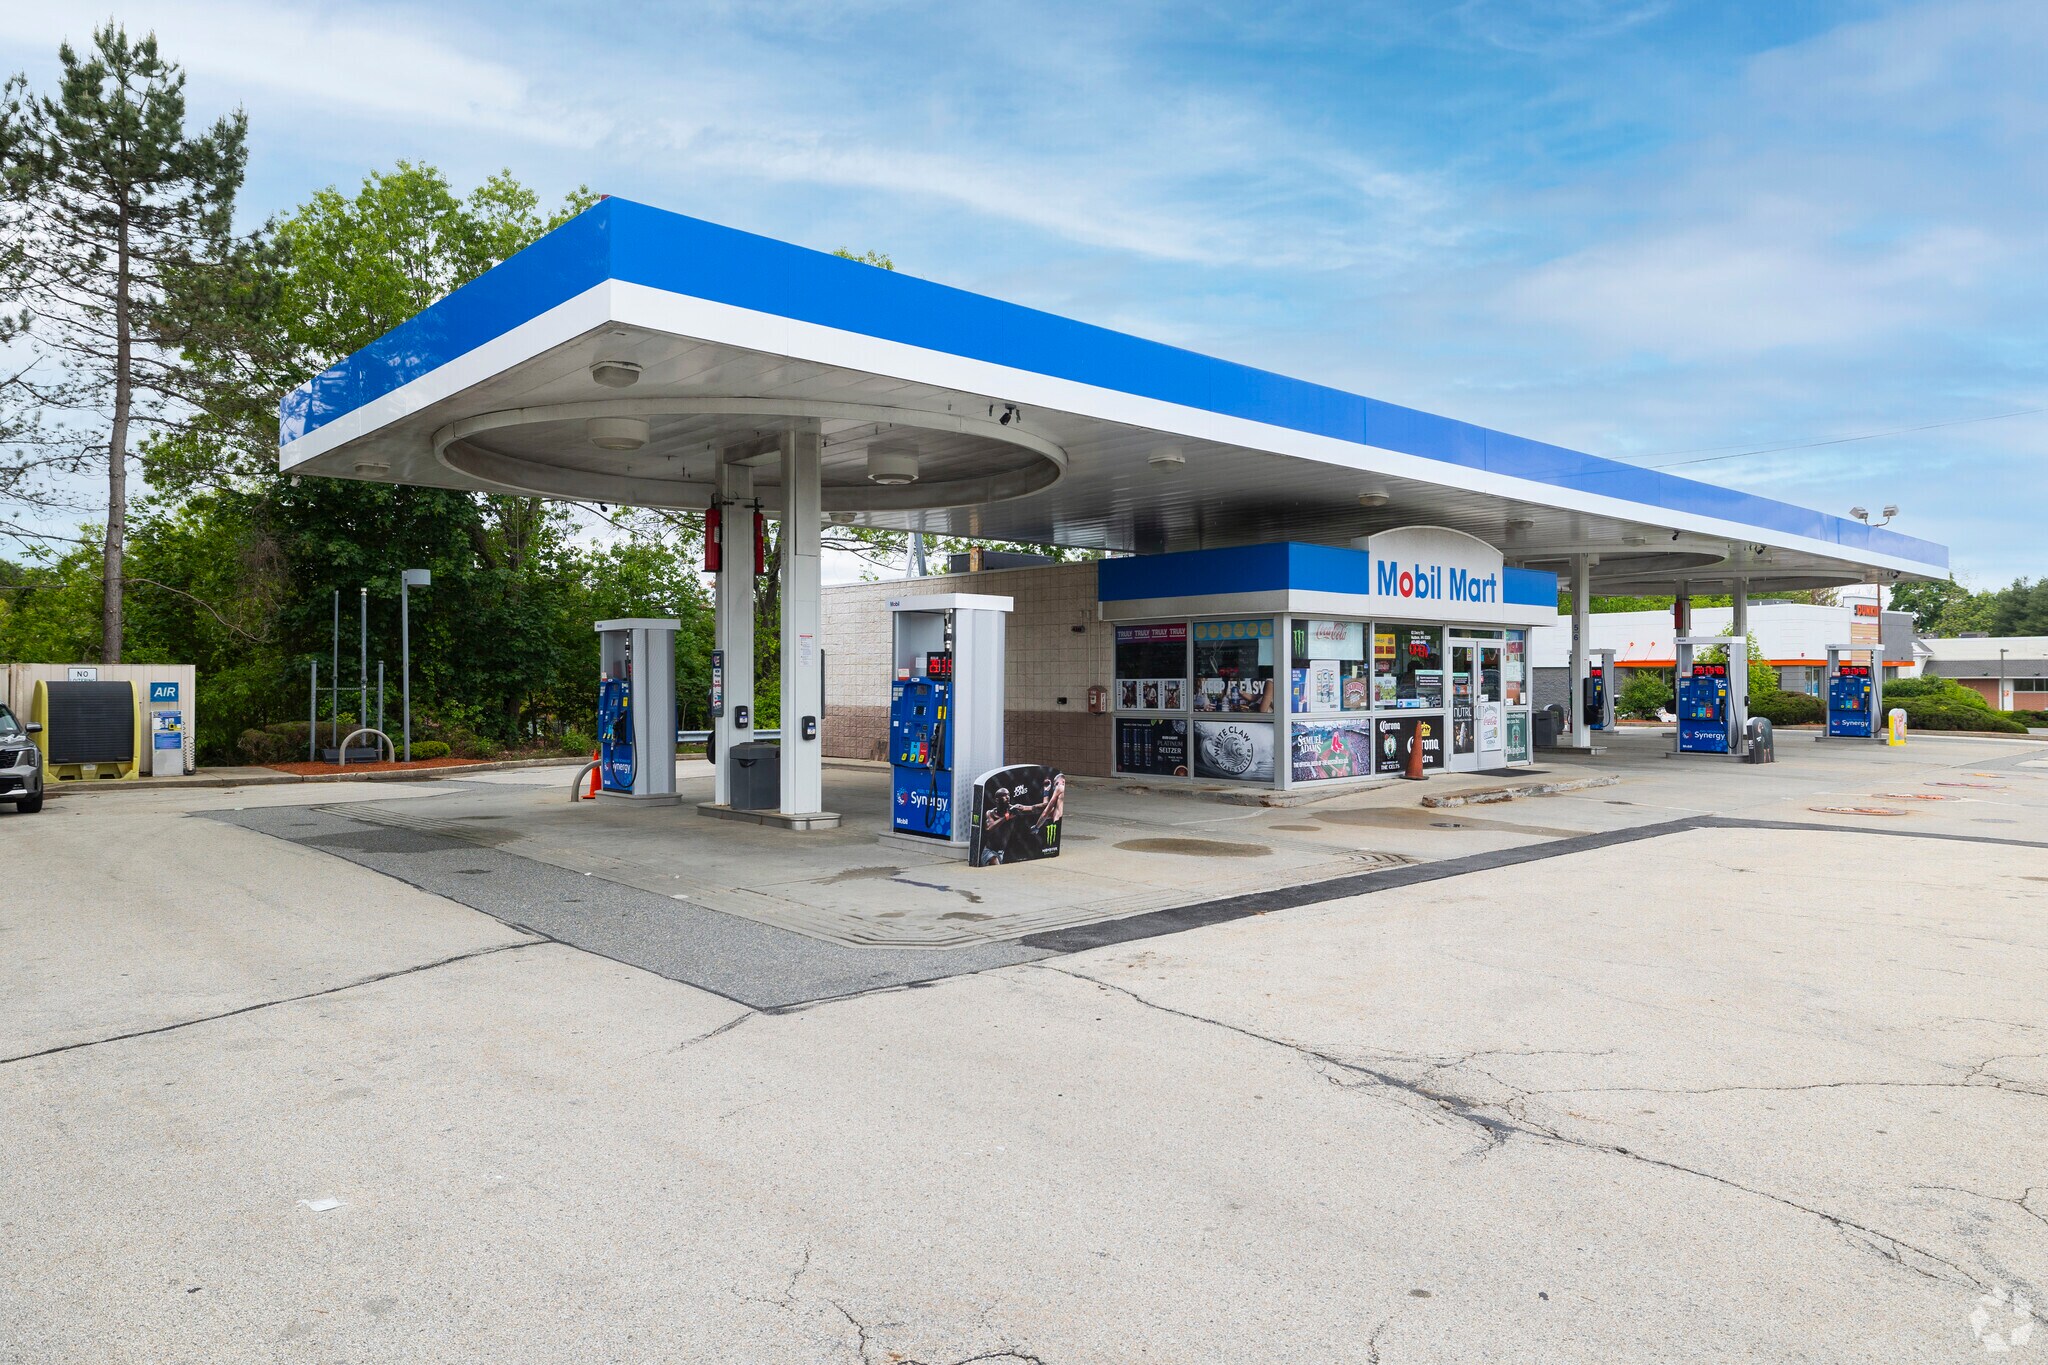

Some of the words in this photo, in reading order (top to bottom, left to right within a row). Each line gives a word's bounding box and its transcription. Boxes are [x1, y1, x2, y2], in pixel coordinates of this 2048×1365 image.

[1378, 560, 1441, 599] Mobil
[1450, 568, 1496, 603] Mart
[154, 687, 176, 697] AIR
[1202, 681, 1226, 694] KEEP
[1240, 681, 1266, 694] EASY
[1380, 720, 1400, 733] Corona
[1214, 729, 1228, 756] WHITE
[1228, 726, 1250, 742] CLAW
[1298, 734, 1323, 746] SAMUEL
[1694, 731, 1725, 740] Synergy
[1300, 743, 1321, 755] ADAMS
[1237, 749, 1251, 772] SELTZER
[1014, 784, 1024, 793] JON
